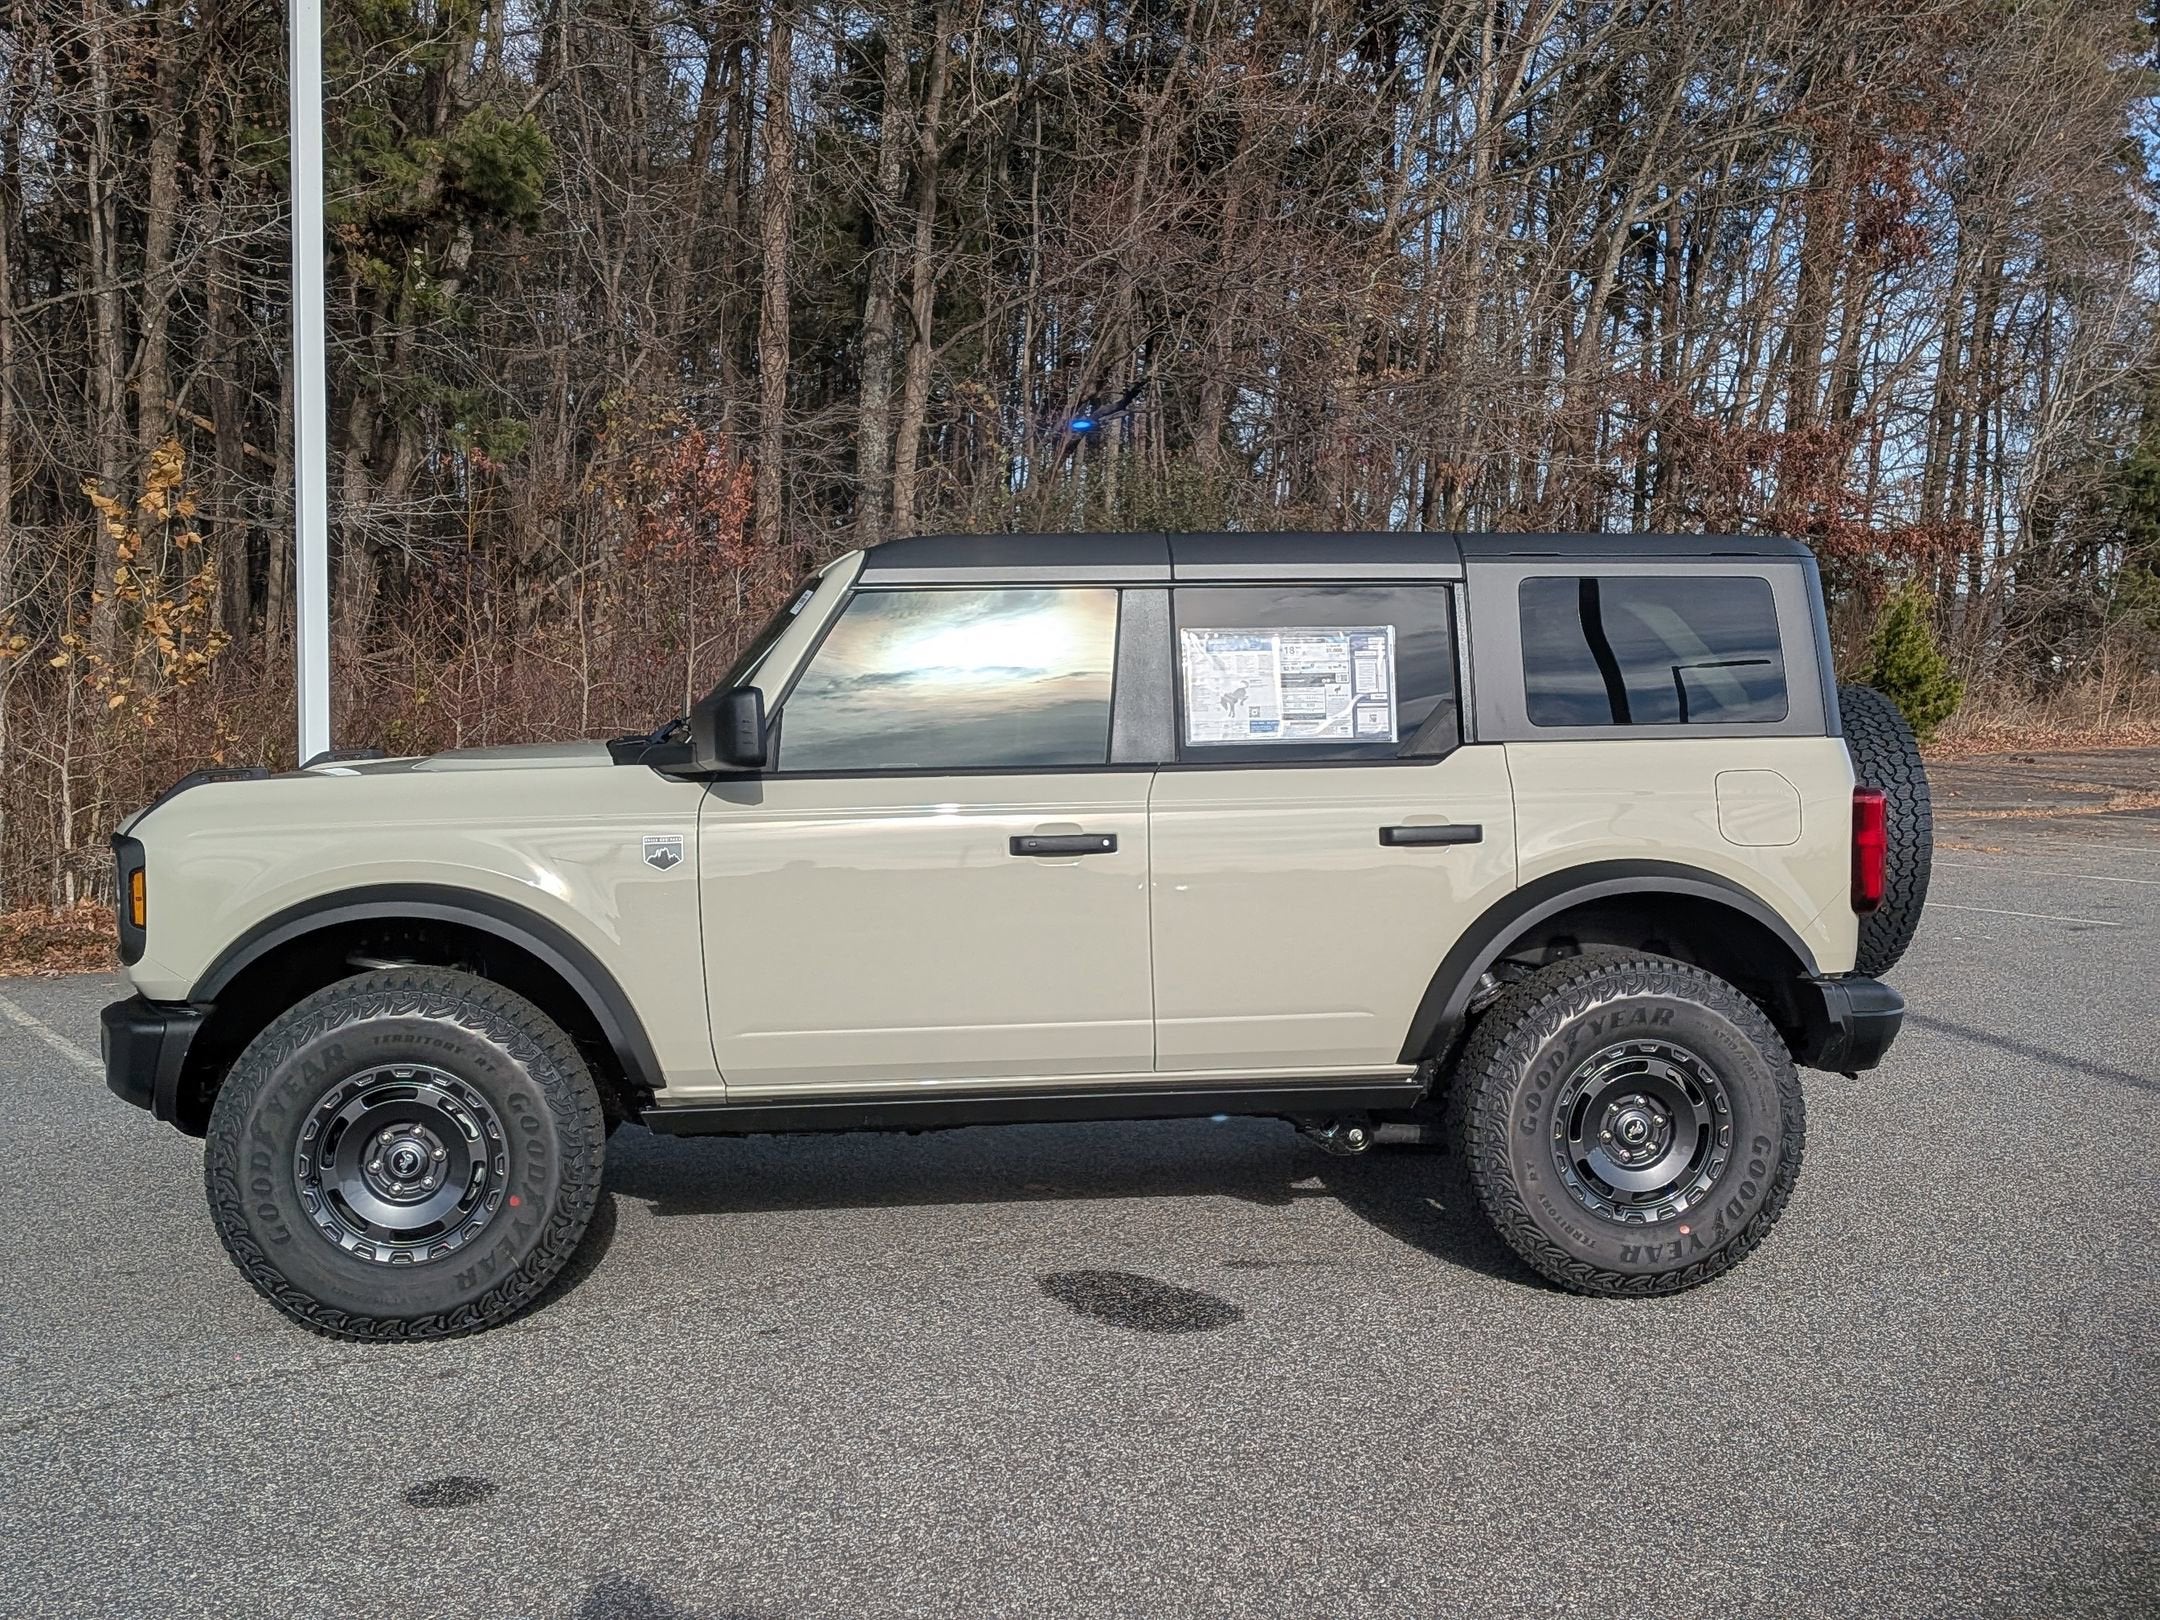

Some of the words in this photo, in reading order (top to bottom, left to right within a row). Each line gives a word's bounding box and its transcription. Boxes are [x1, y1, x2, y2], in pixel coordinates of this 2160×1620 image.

[373, 1034, 465, 1054] TERRITORY
[1519, 1006, 1676, 1136] GOODYEAR
[250, 1042, 349, 1248] GOODYEAR
[453, 1091, 548, 1291] GOODYEAR
[1620, 1134, 1773, 1266] GOODYEAR
[1538, 1193, 1597, 1249] TERRITORY
